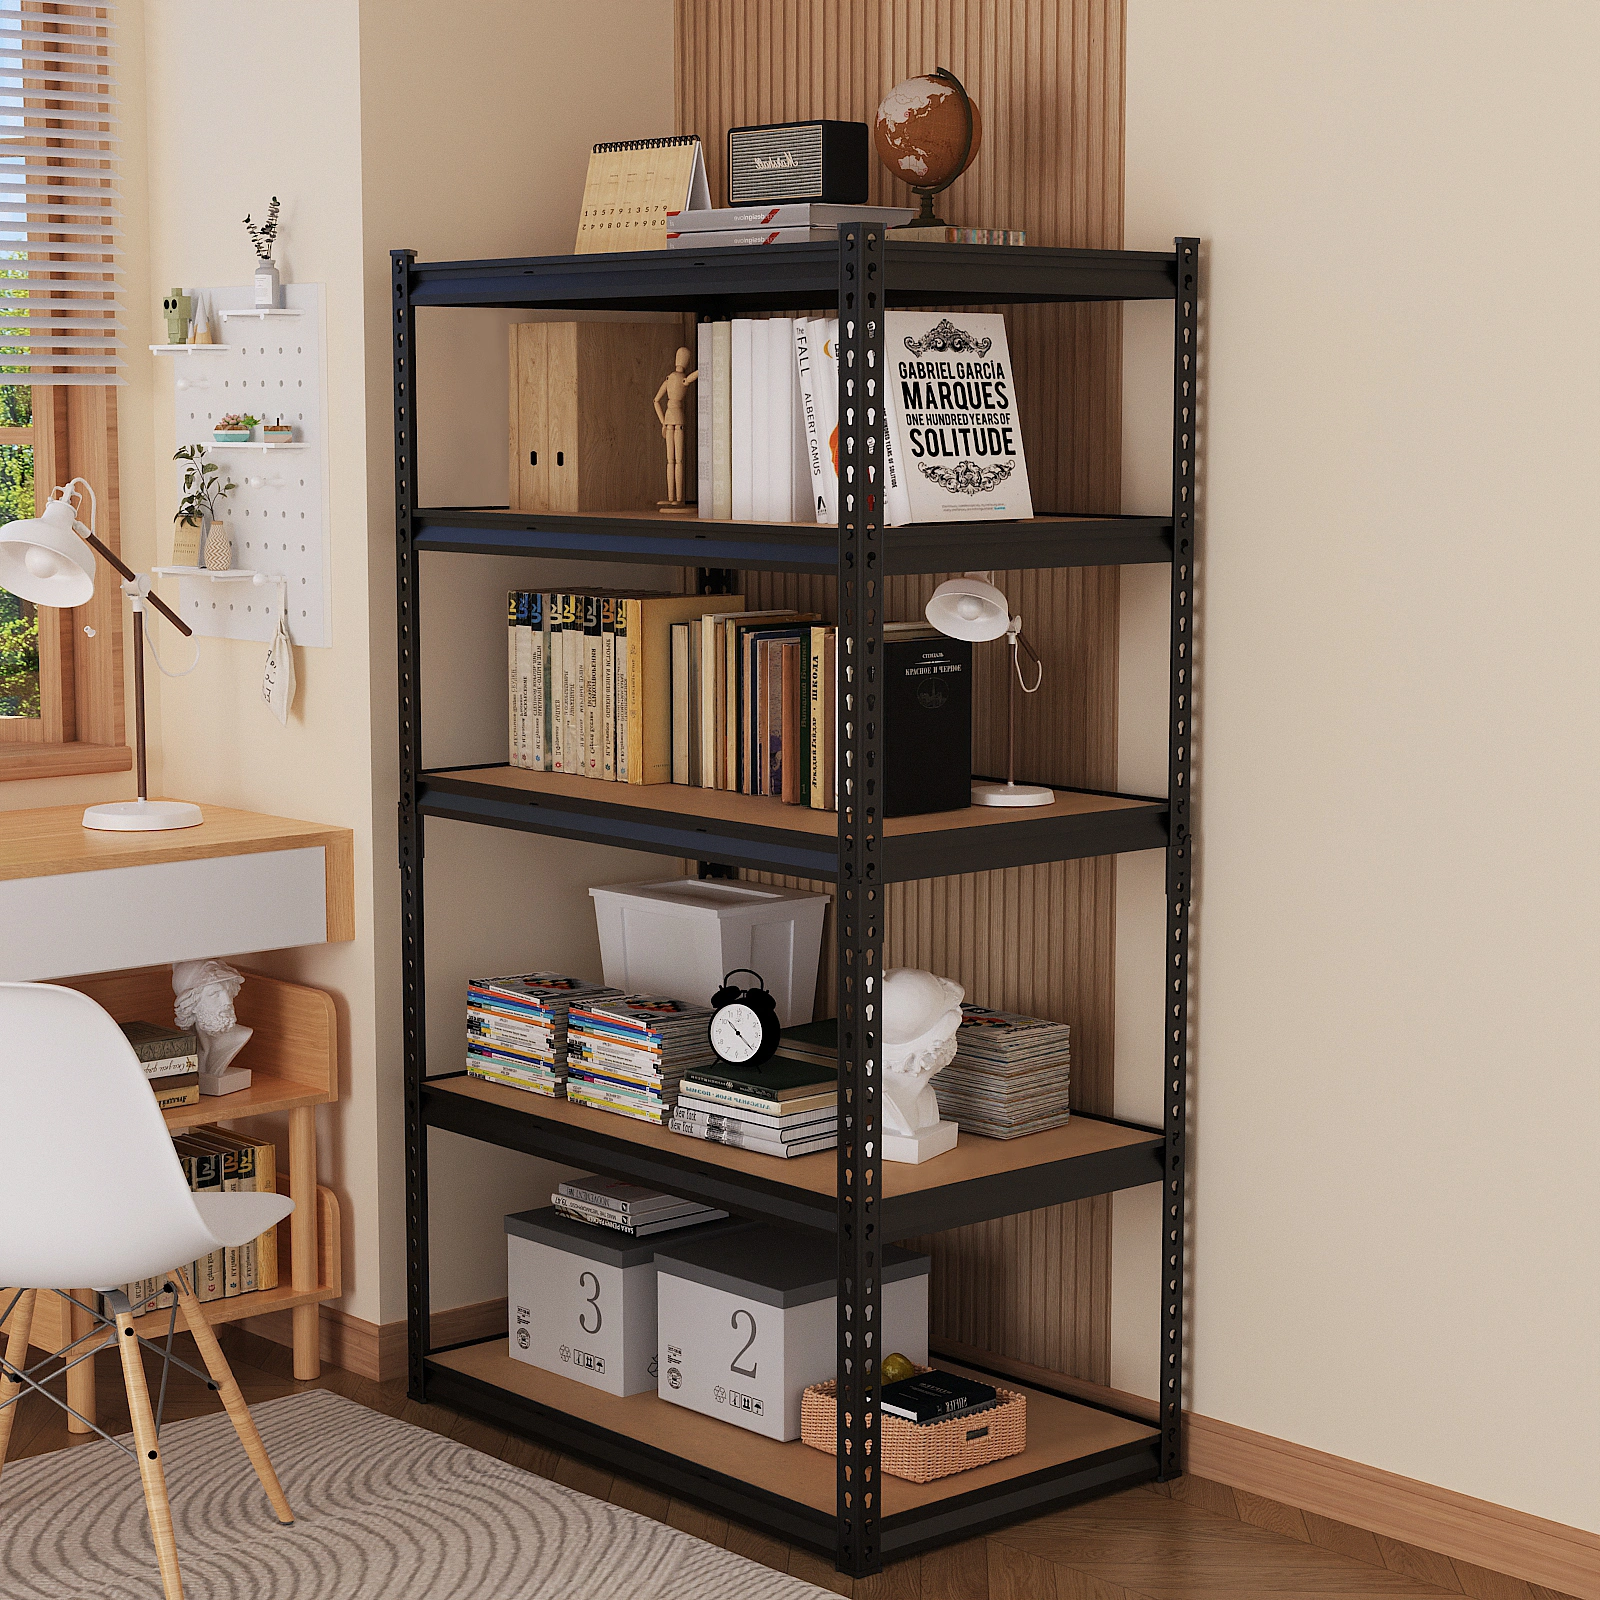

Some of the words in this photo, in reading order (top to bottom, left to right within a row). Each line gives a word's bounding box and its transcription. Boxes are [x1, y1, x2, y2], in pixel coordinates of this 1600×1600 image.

[797, 336, 810, 377] FALL
[899, 361, 955, 379] GABRIEL
[956, 360, 1005, 379] GARCÍA
[901, 381, 1009, 410] MÁRQUES
[906, 413, 924, 425] ONE
[926, 413, 968, 425] HUNDRED
[968, 413, 999, 425] YEARS
[1000, 413, 1011, 425] OF
[804, 393, 816, 434] ALBERT
[810, 438, 821, 476] CAMUS
[909, 428, 1017, 457] SOLITUDE
[885, 441, 893, 457] YEARS
[889, 465, 898, 488] SOLITUDE
[905, 667, 932, 676] КРАСНОЕ
[933, 666, 938, 674] И
[939, 664, 962, 673] ЧЕРНОЕ
[682, 1122, 694, 1134] York
[686, 1109, 697, 1121] York
[620, 1224, 634, 1235] SARA
[578, 1271, 603, 1334] 3
[730, 1309, 757, 1379] 2
